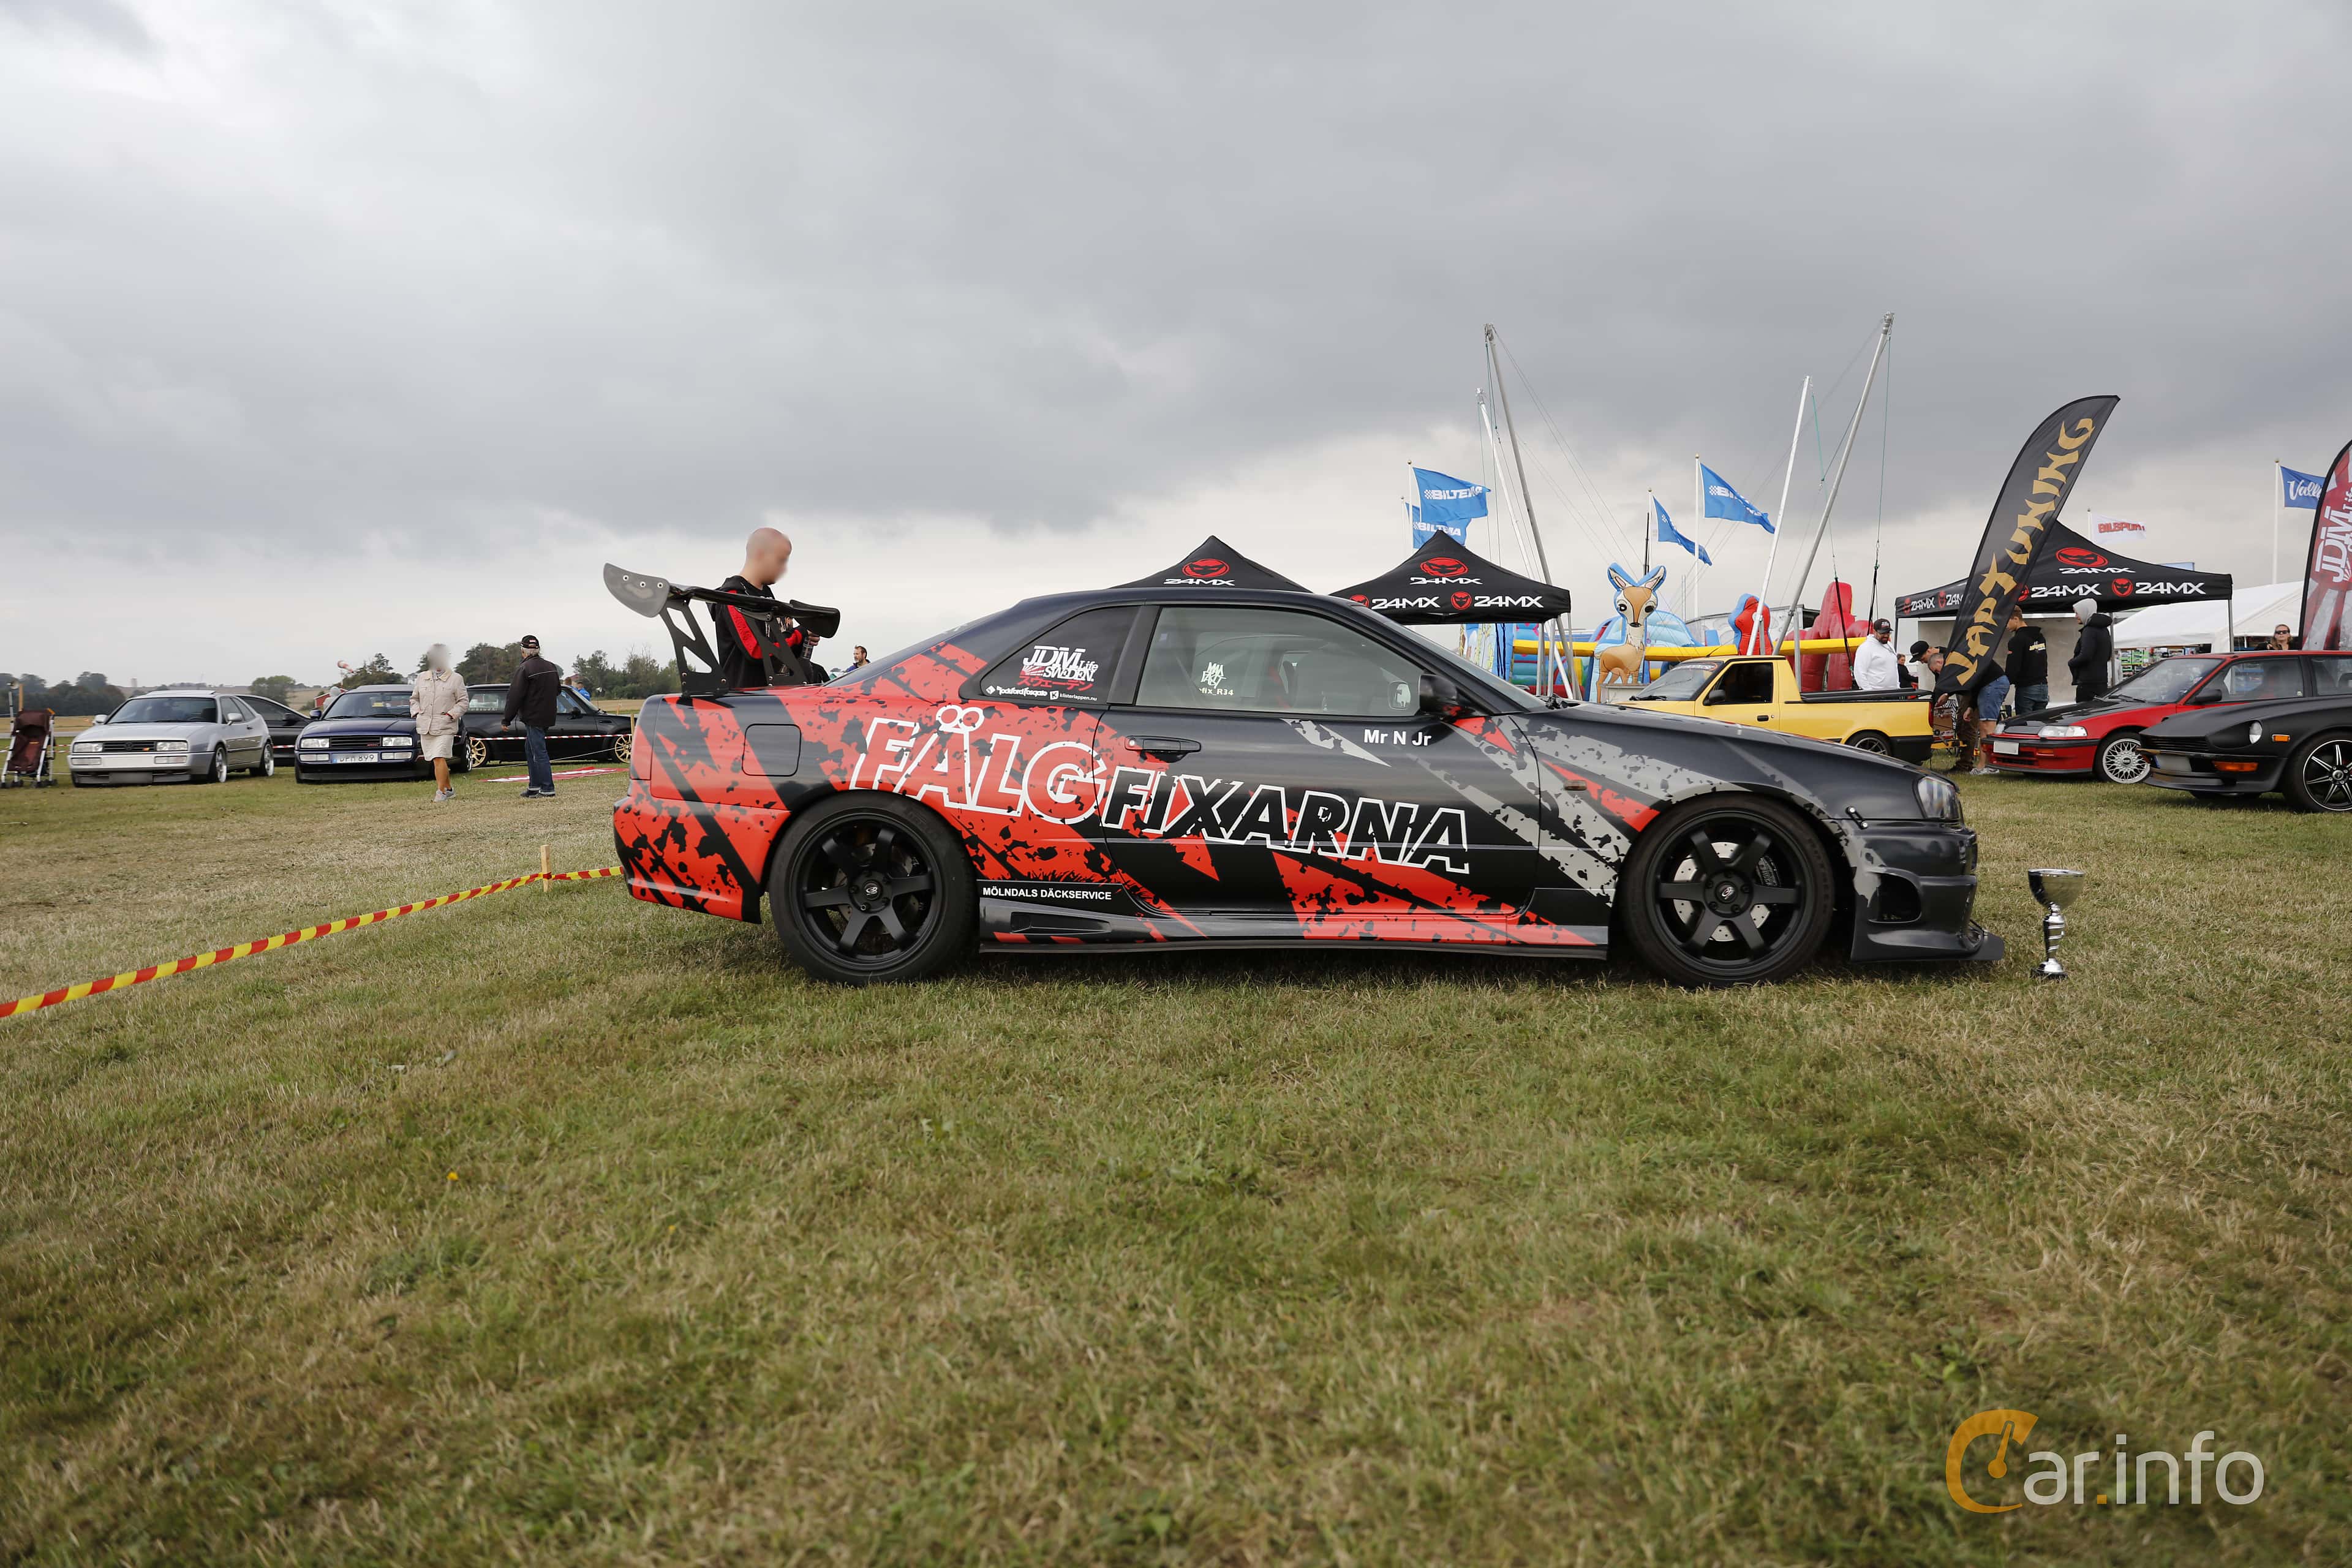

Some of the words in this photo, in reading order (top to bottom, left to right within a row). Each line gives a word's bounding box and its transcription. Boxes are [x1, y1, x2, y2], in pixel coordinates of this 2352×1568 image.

[2030, 583, 2102, 598] 24MX
[2135, 582, 2206, 595] 24MX
[1371, 597, 1441, 610] 24MX
[1474, 595, 1544, 608] 24MX
[1023, 645, 1086, 670] JDM
[1017, 675, 1093, 692] スウェーデン
[1364, 729, 1389, 744] Mr
[1393, 731, 1406, 745] N
[1412, 732, 1432, 746] Jr
[982, 886, 1038, 897] MÖLNDALS
[1041, 888, 1112, 900] DÄCKSERVICE
